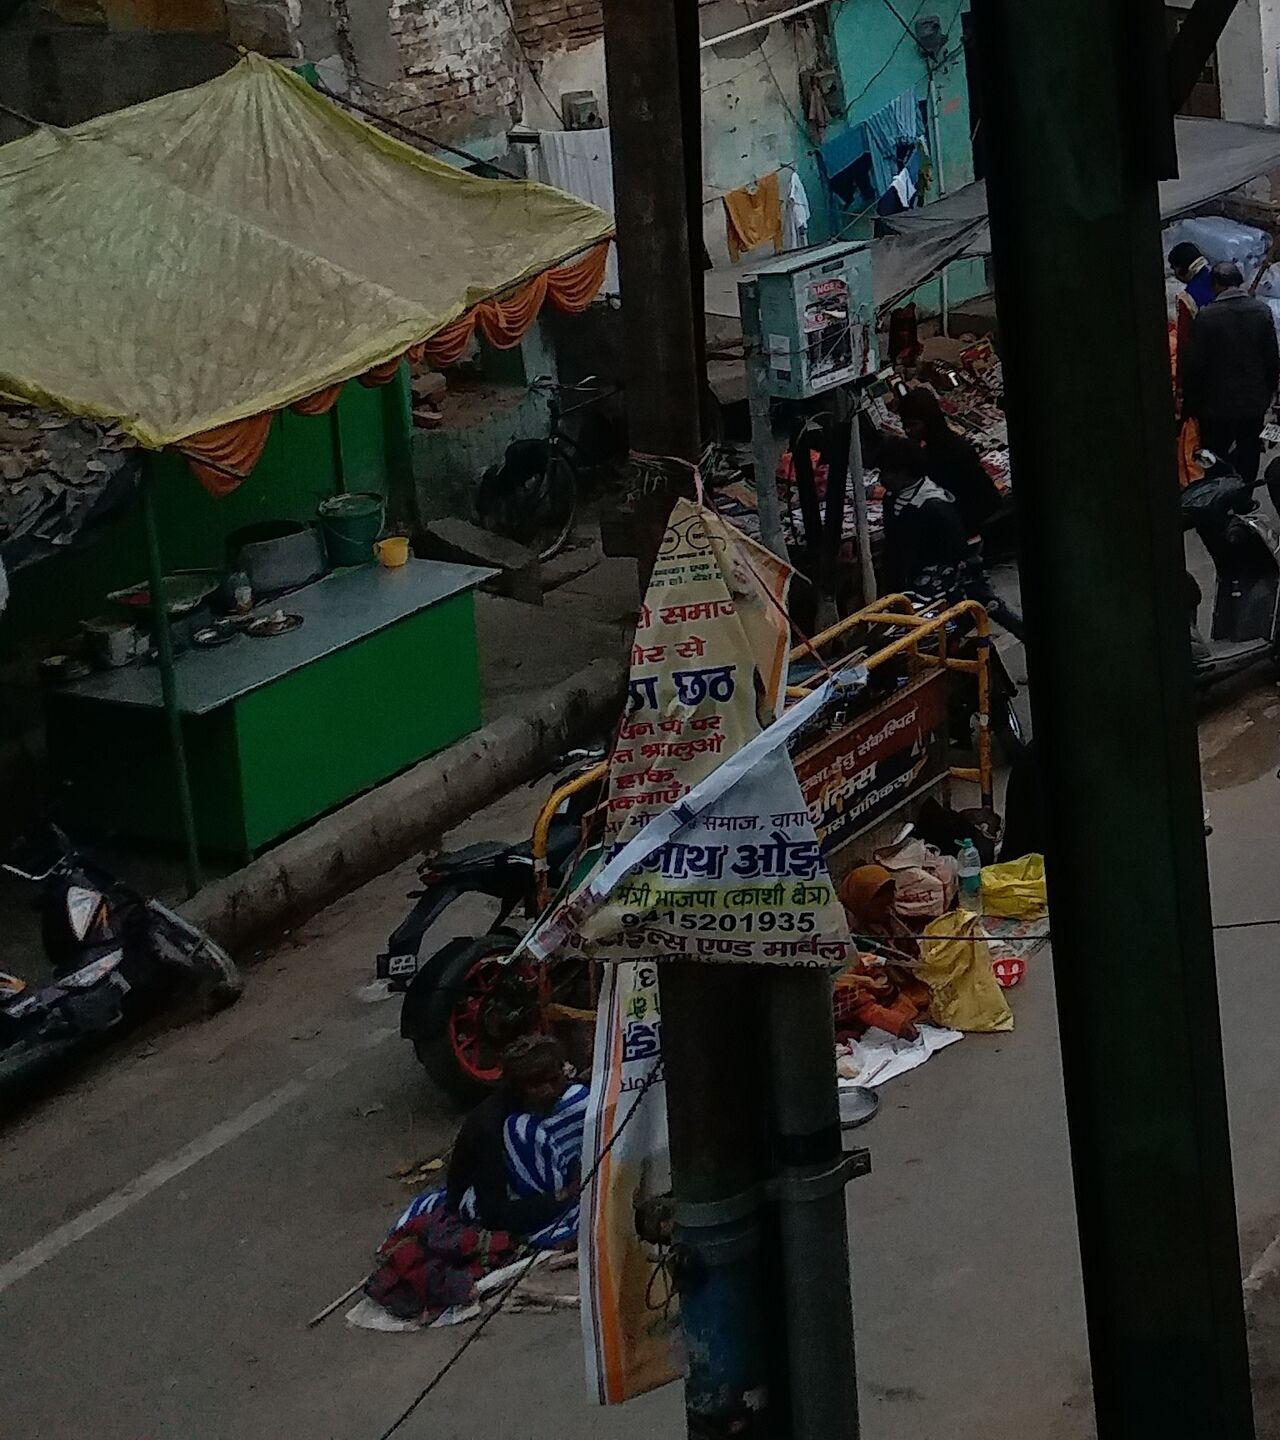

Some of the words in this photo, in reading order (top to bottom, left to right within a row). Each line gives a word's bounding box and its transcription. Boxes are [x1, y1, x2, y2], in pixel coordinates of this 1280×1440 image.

[675, 635, 706, 658] से
[672, 665, 737, 706] छठ
[655, 889, 717, 907] भाजपा
[724, 883, 784, 907] (काशी
